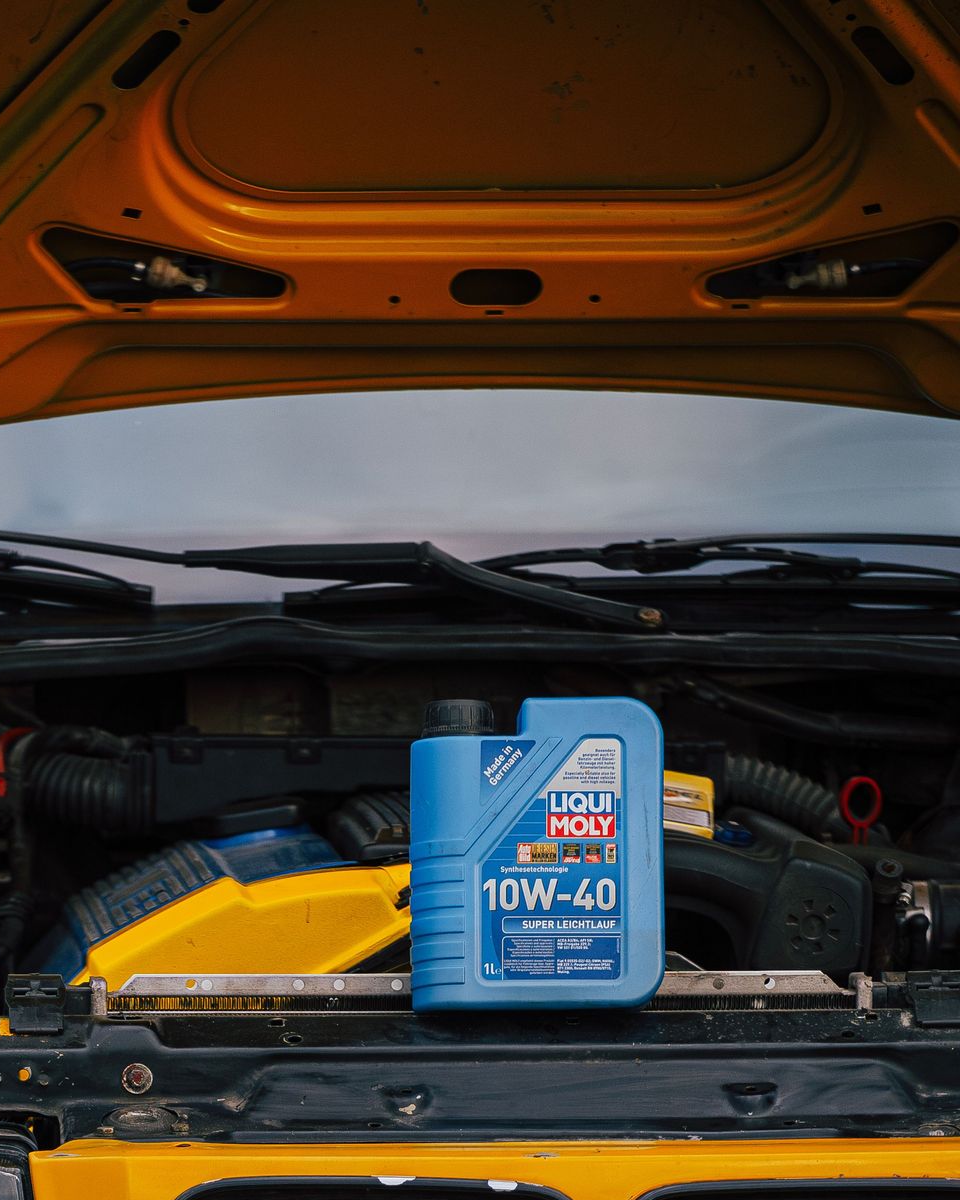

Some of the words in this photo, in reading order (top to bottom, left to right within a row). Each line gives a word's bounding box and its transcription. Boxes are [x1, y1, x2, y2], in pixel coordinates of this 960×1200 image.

[483, 754, 506, 778] Made
[502, 745, 513, 756] in
[489, 748, 523, 786] Germany
[550, 792, 612, 814] LIQUI
[550, 816, 614, 836] MOLY
[500, 866, 568, 874] Synthesetechnologie
[483, 878, 617, 911] 10W-40
[522, 920, 554, 929] SUPER
[557, 920, 616, 929] LEICHTLAUF
